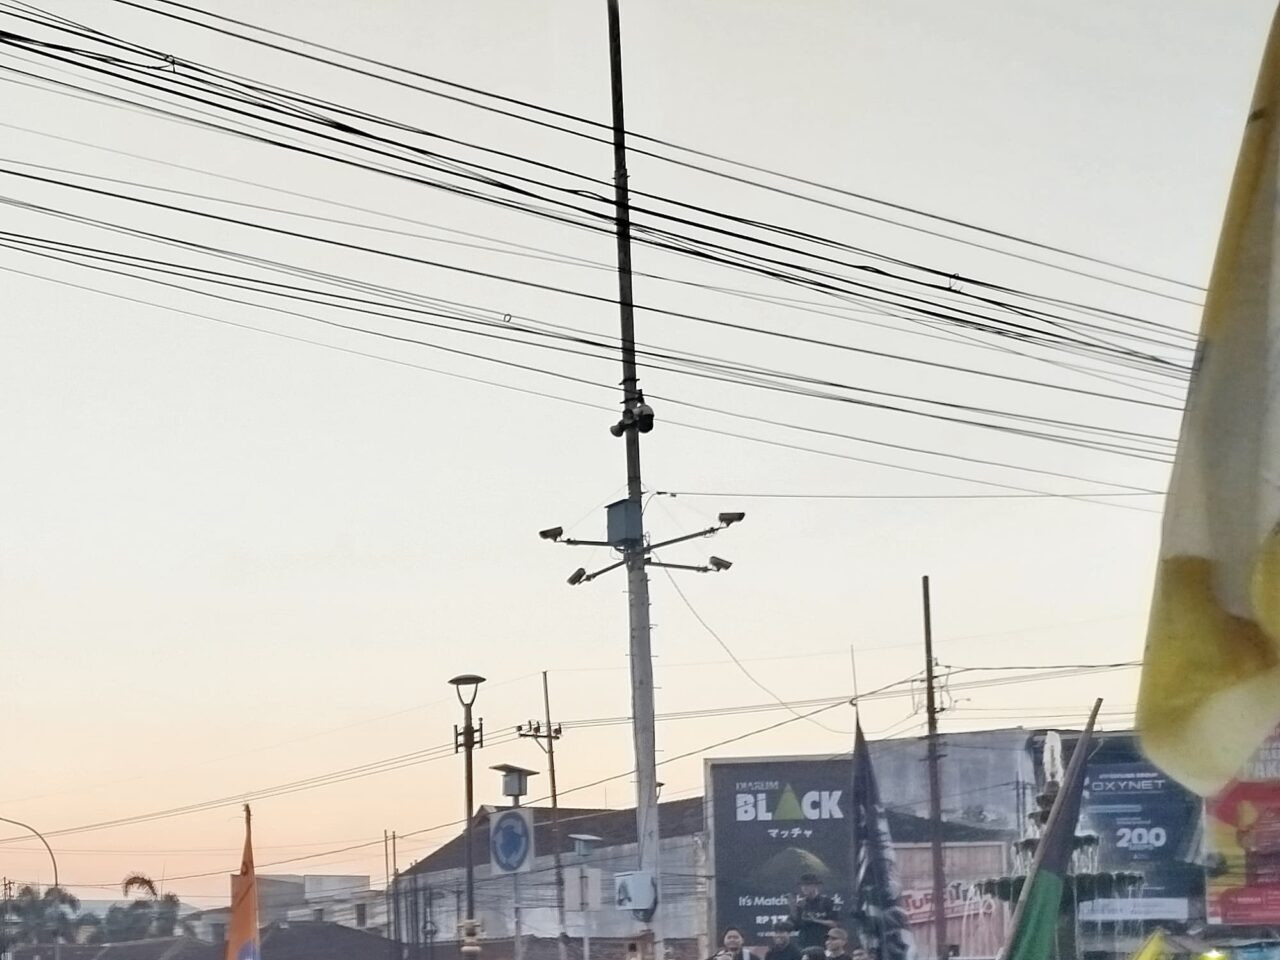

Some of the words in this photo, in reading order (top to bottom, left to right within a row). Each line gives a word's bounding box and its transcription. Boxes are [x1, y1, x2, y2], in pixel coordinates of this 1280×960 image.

[1091, 780, 1165, 791] OXYNET
[736, 784, 844, 821] BLACK
[1116, 827, 1167, 847] 200
